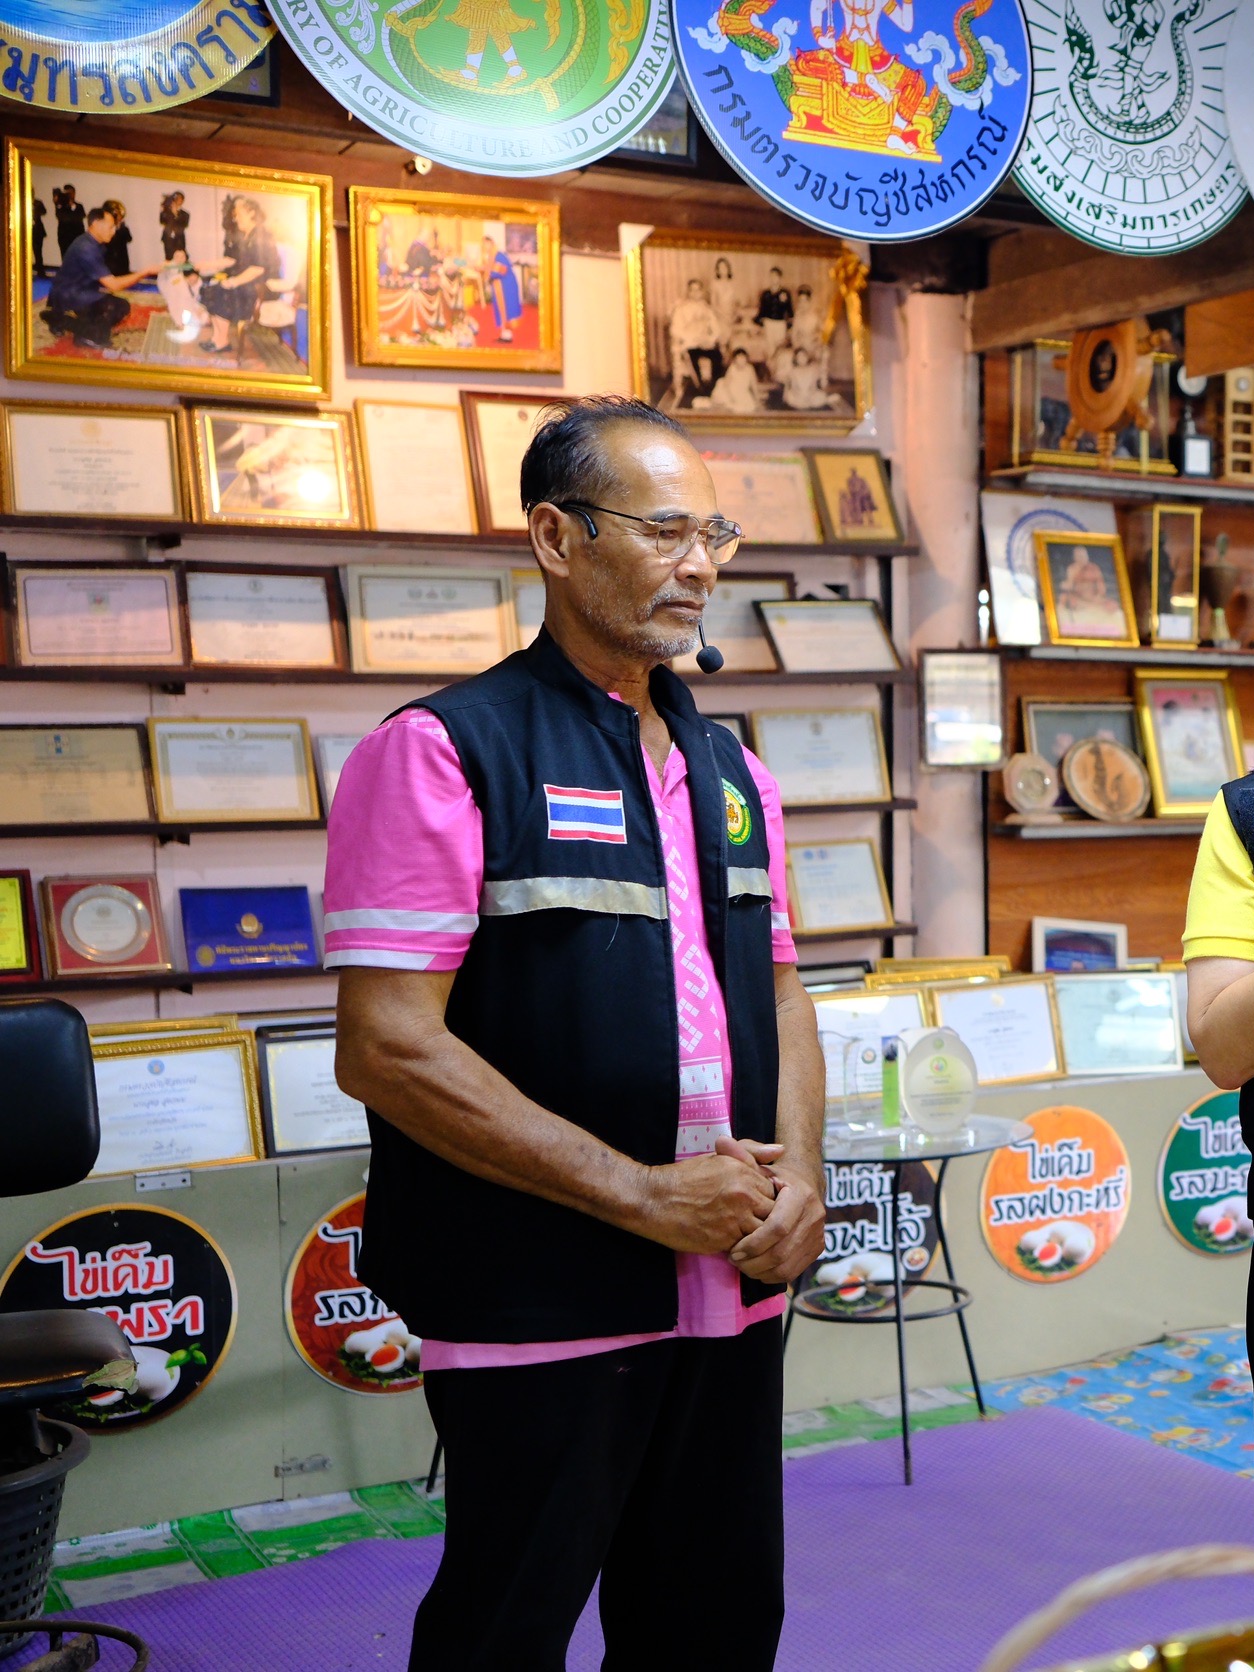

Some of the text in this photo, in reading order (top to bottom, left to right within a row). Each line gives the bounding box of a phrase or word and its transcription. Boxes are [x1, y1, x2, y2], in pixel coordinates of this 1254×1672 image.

[313, 35, 349, 70] OF
[343, 73, 533, 158] AGRICULTURE
[541, 126, 589, 151] AND
[592, 0, 670, 135] COOPERATIV
[702, 63, 1009, 227] กรมตรวจบัญชีสหกรณ์
[1025, 136, 1238, 232] รมส่งเสริมการเกษตร
